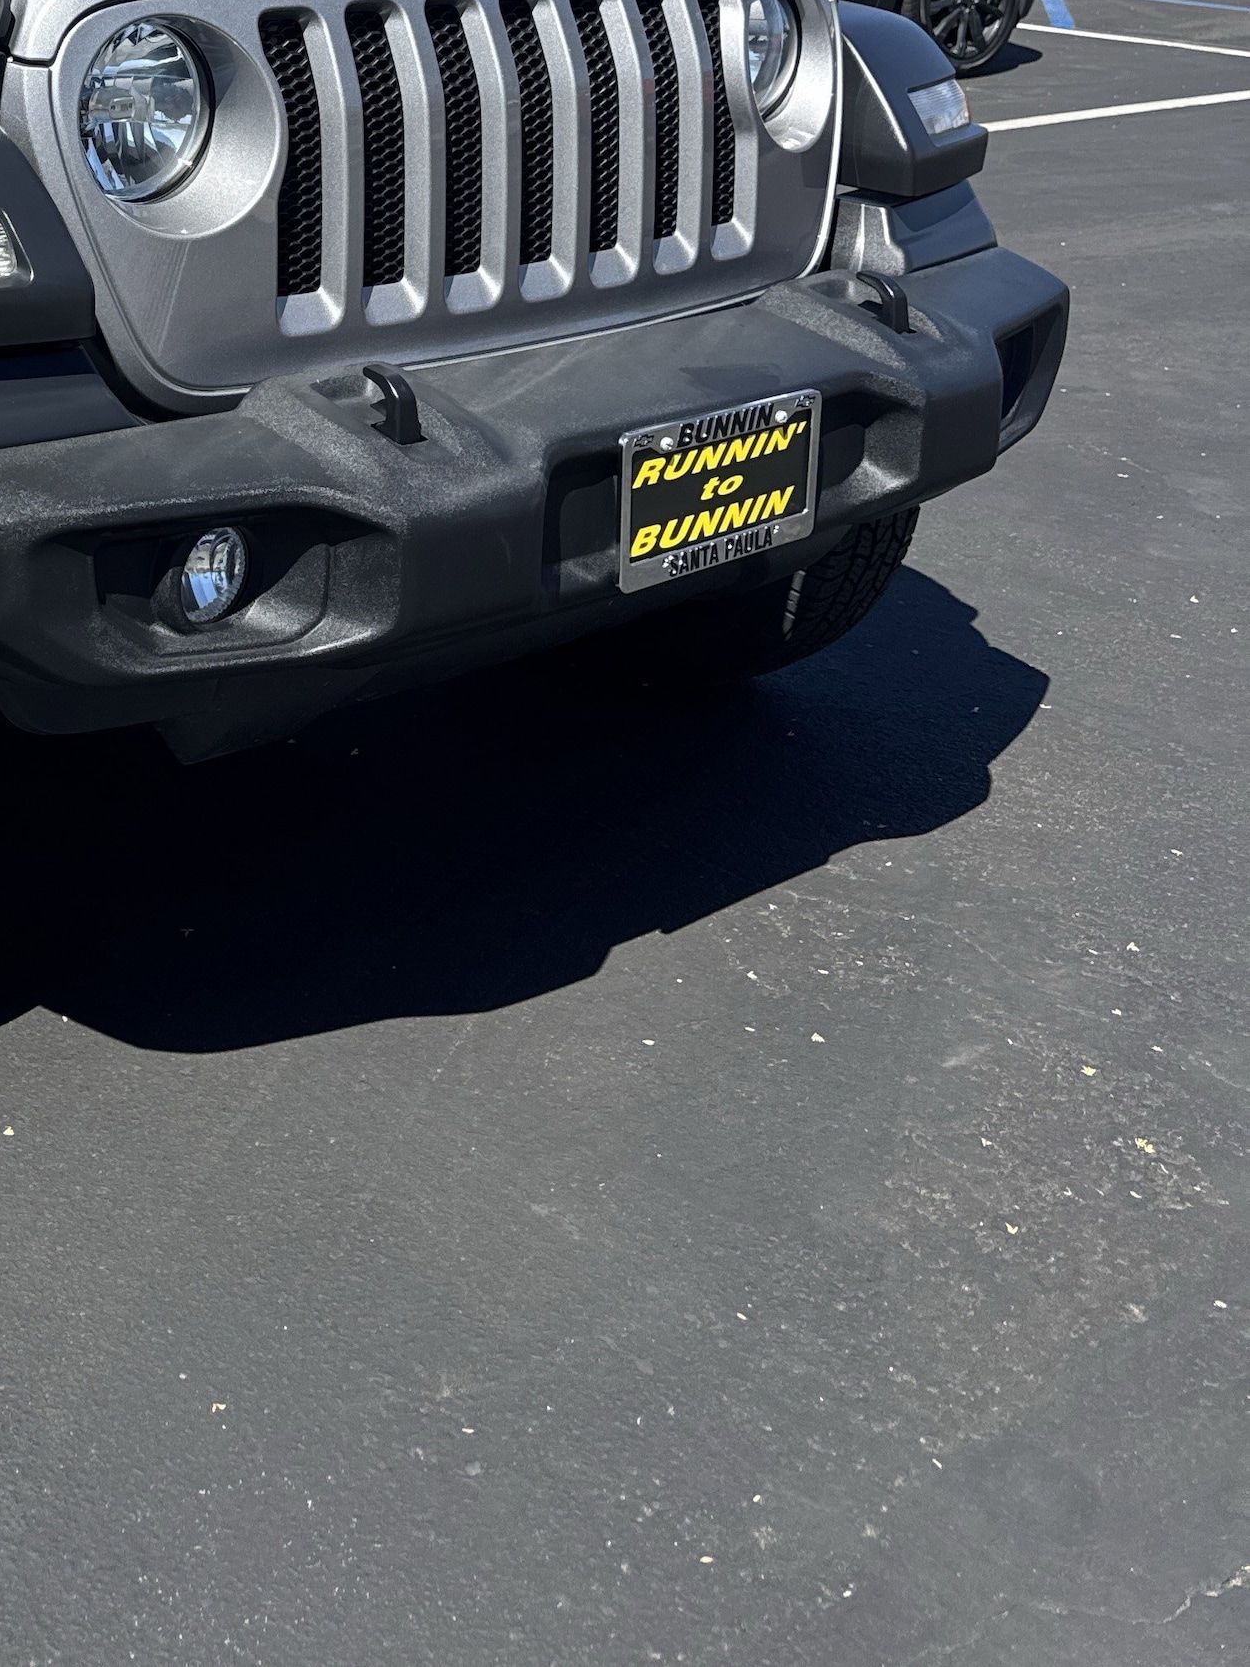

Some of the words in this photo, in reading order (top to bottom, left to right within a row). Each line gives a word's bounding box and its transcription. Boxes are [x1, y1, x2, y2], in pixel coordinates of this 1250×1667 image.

[676, 402, 774, 449] BUNNIN
[631, 420, 808, 490] RUNNIN'
[699, 474, 745, 502] to
[629, 484, 796, 559] BUNNIN
[668, 543, 720, 577] SANTA
[724, 525, 774, 561] PAULA
